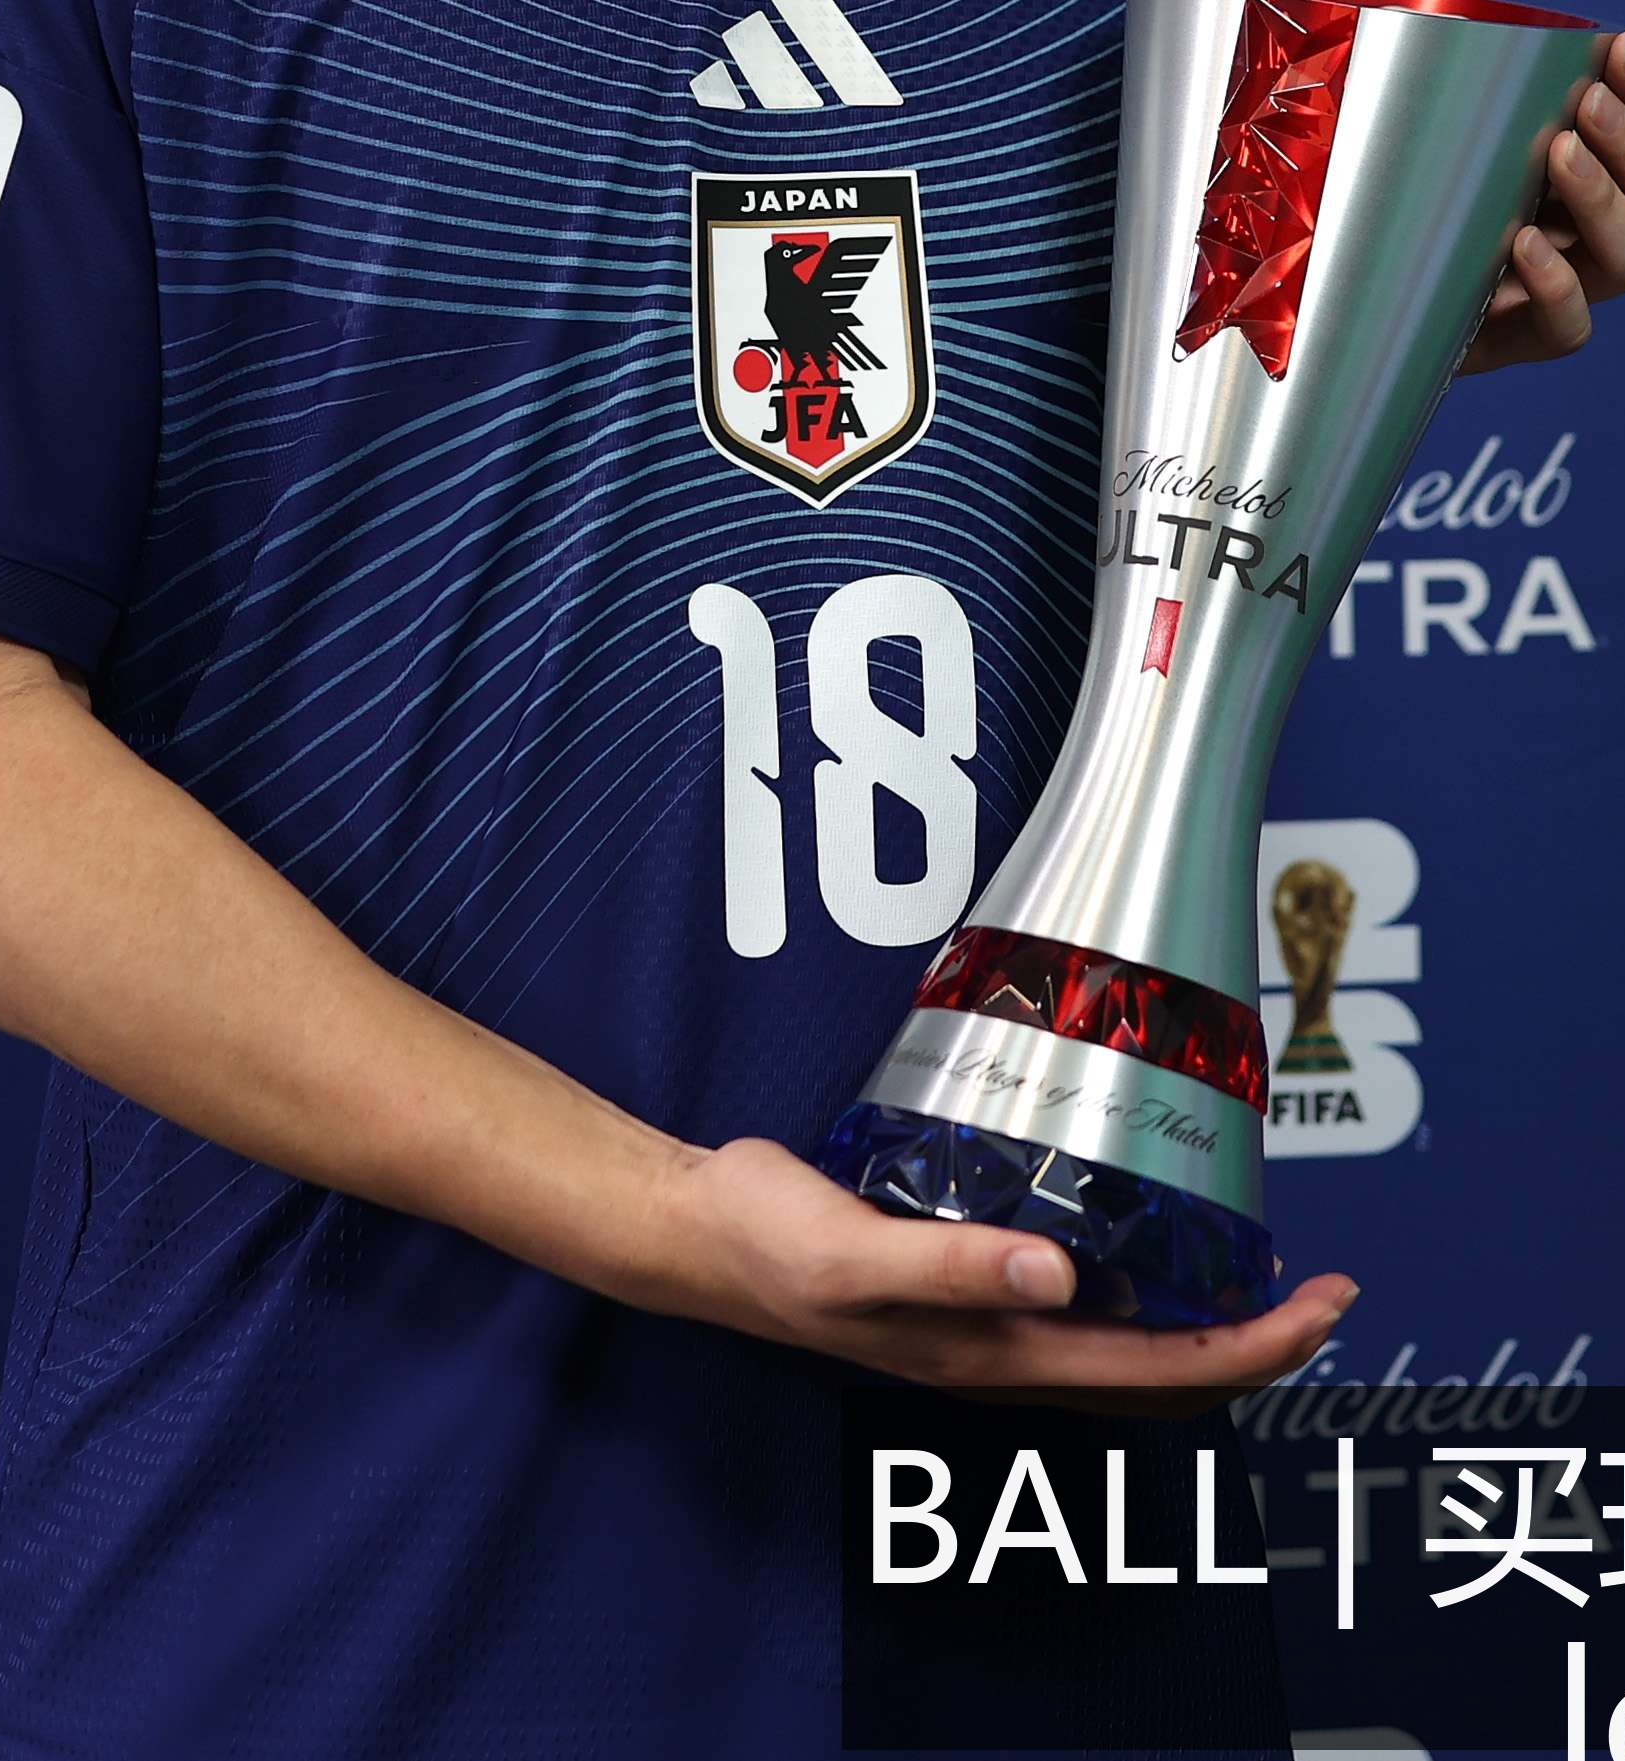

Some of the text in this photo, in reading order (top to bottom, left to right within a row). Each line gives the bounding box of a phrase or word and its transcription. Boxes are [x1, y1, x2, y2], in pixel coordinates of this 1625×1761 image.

[740, 187, 859, 213] JAPAN
[760, 393, 868, 444] JFA
[1113, 450, 1292, 519] Michelob
[1378, 432, 1576, 531] elob
[1330, 556, 1595, 658] TRA
[688, 574, 978, 959] 18
[1123, 1098, 1221, 1154] Match
[1271, 1090, 1363, 1127] FIFA
